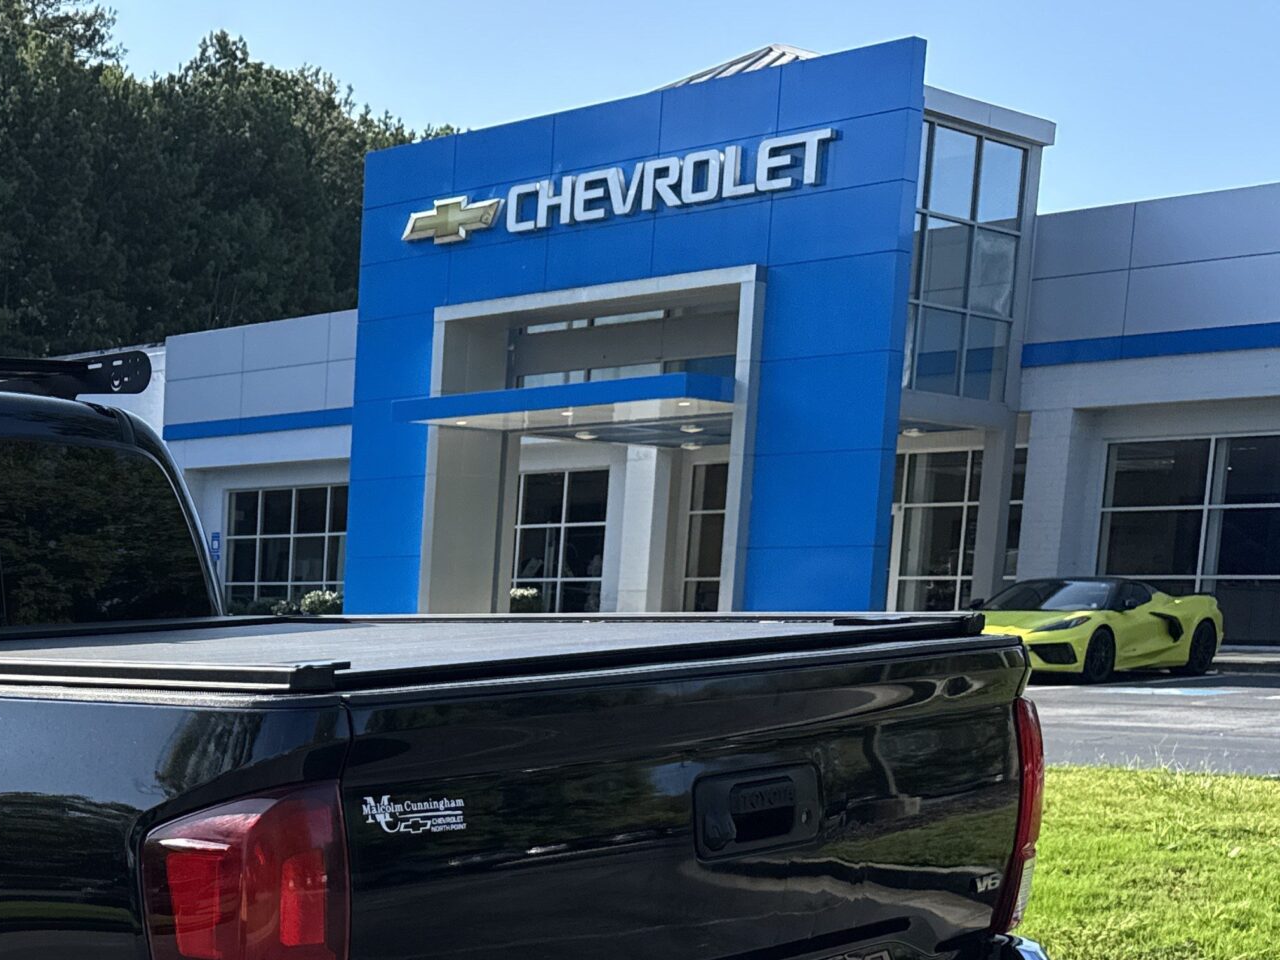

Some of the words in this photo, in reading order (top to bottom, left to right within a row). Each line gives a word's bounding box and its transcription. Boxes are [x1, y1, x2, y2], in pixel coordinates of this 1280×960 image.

[506, 128, 835, 233] CHEVROLET
[362, 801, 403, 815] Malcolm
[404, 798, 464, 811] Cunningham
[976, 874, 1001, 893] V6
